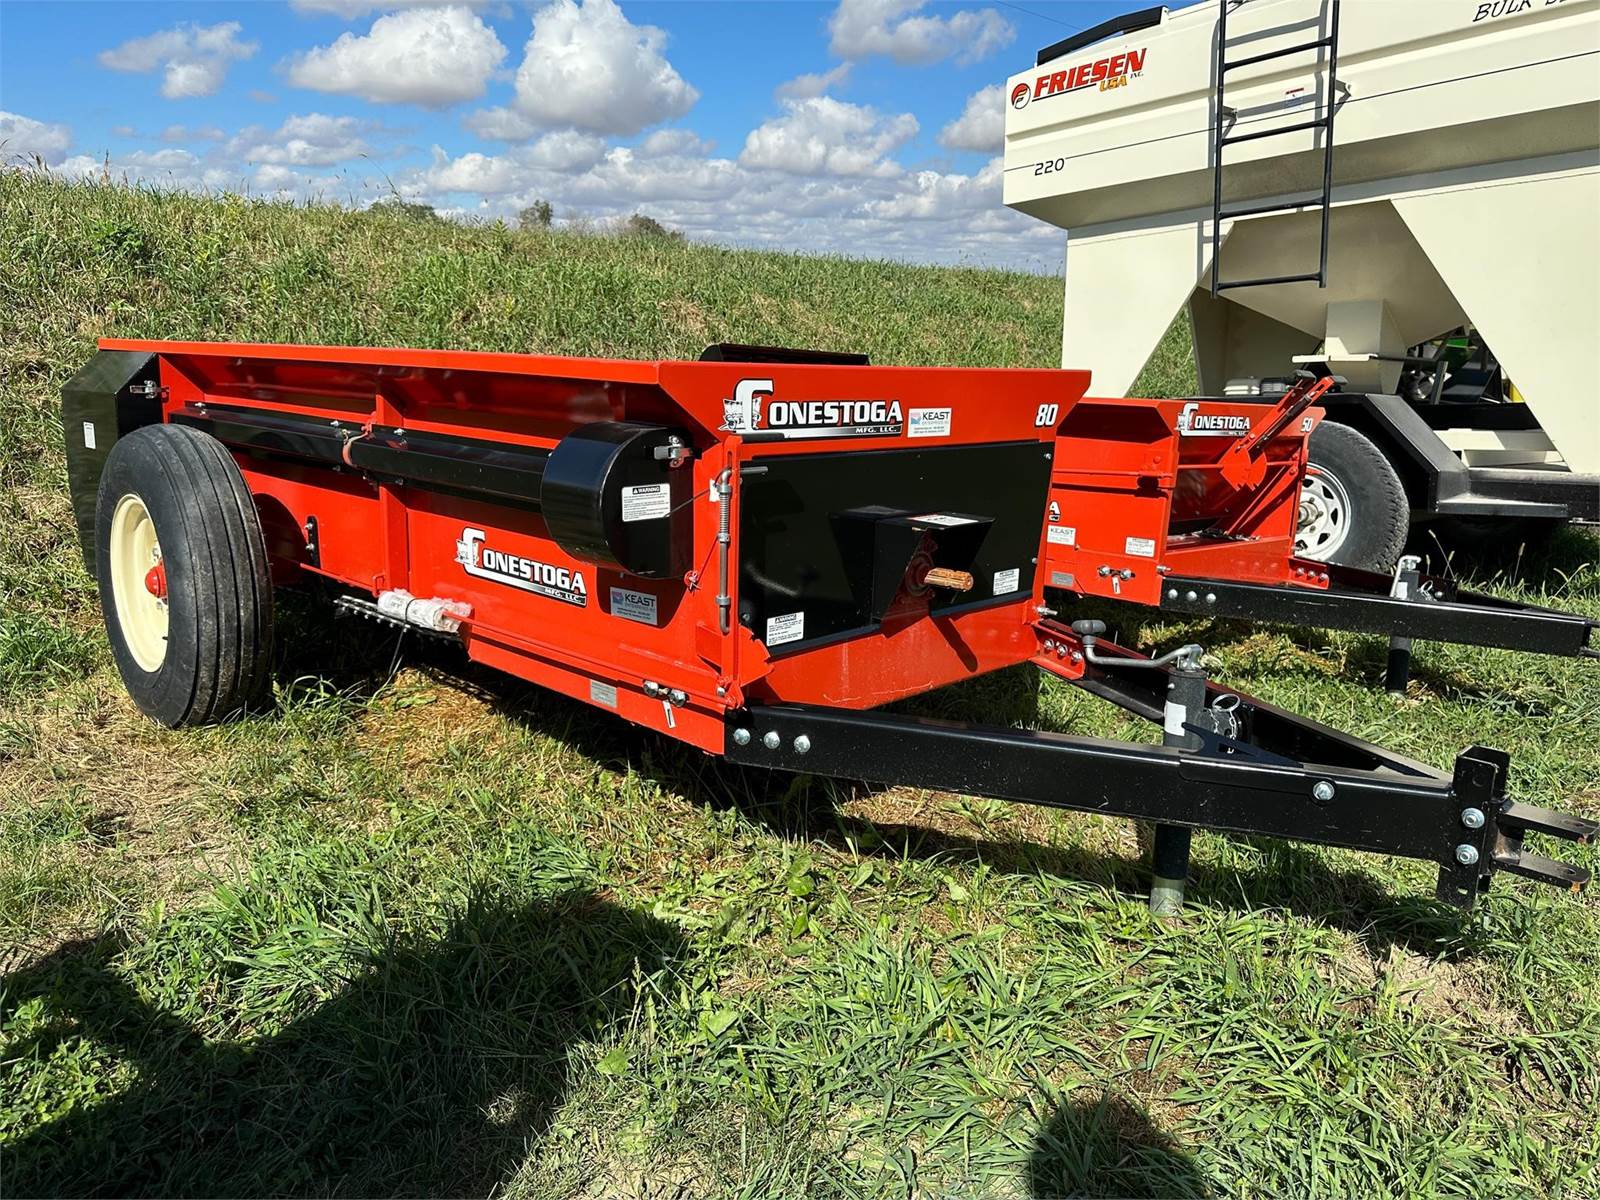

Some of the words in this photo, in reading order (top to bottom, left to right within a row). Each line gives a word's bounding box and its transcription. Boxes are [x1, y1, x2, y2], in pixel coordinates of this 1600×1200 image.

[1472, 0, 1532, 22] BULK
[1033, 47, 1148, 99] FRIESEN
[1099, 75, 1128, 92] USA
[1034, 158, 1065, 176] 220
[734, 378, 903, 438] CONESTOGA
[922, 411, 950, 421] KEAST
[1035, 403, 1059, 426] 80
[879, 425, 897, 433] LLC.
[1181, 402, 1251, 436] CONESTOGA
[1300, 417, 1314, 432] 50
[461, 527, 588, 602] CONESTOGA
[624, 593, 656, 608] KEAST
